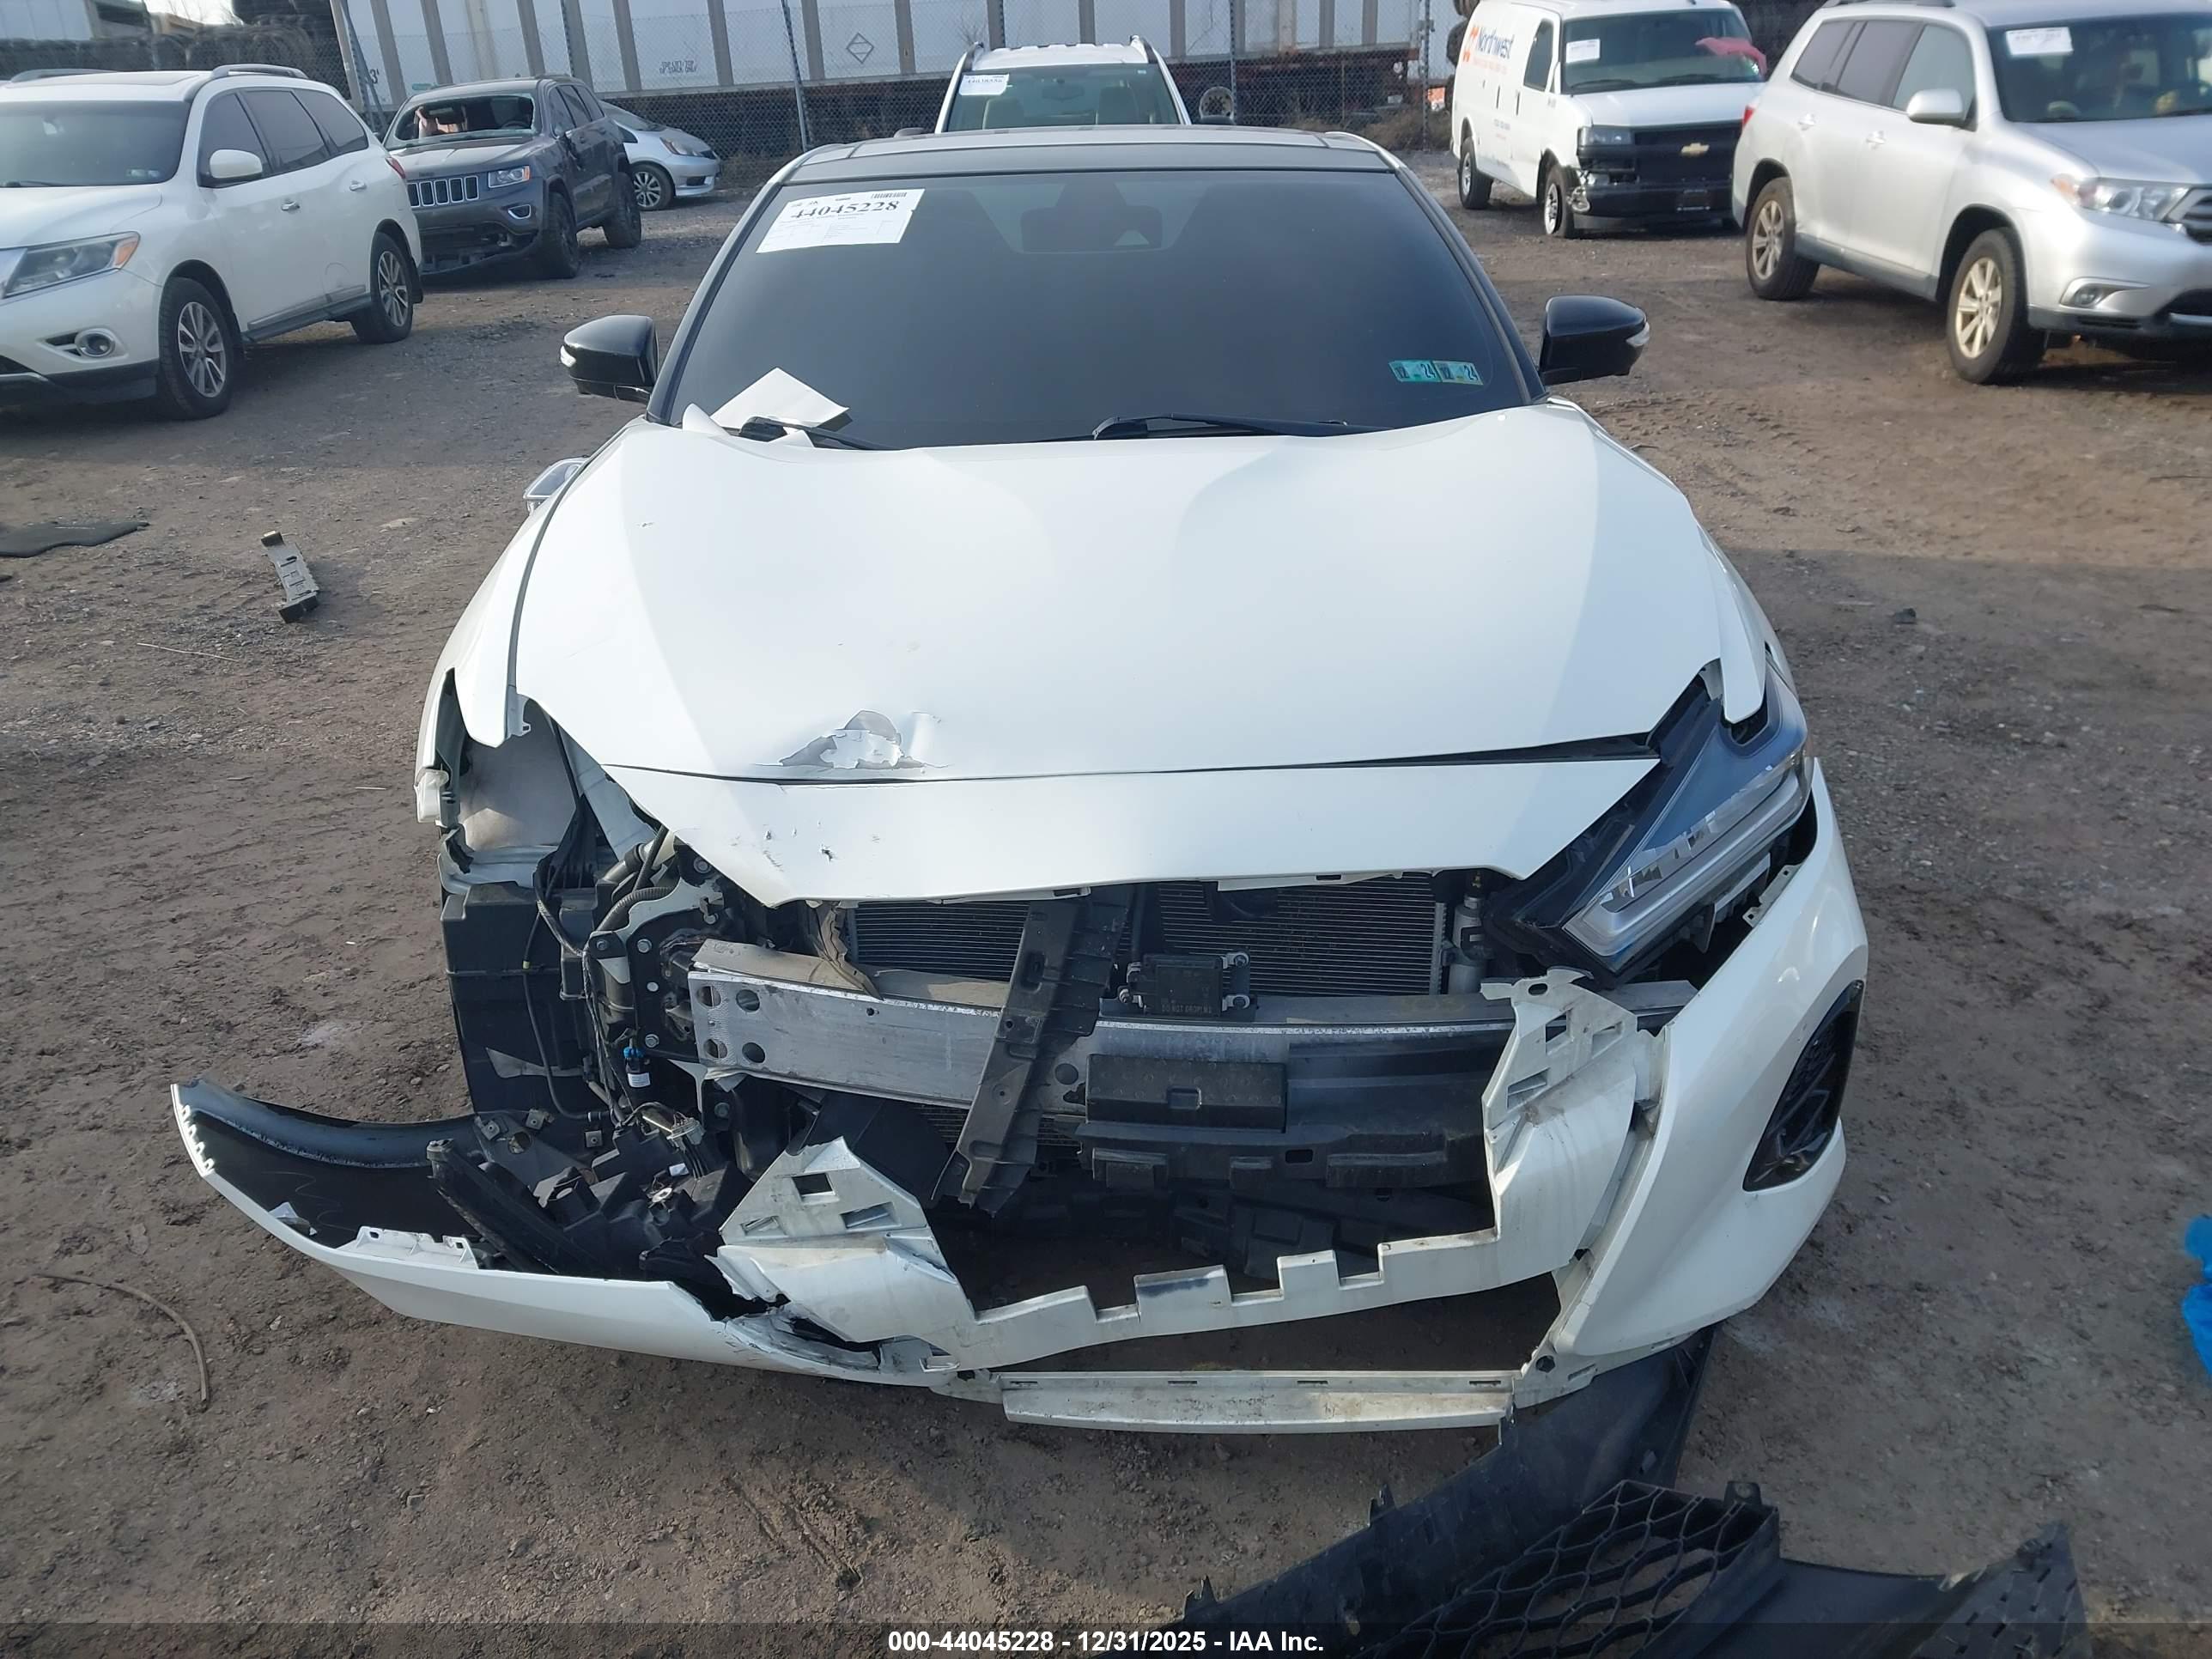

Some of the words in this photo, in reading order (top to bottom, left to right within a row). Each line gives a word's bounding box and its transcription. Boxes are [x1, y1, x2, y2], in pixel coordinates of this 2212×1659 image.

[1477, 27, 1515, 59] Northwest
[790, 200, 900, 218] 44045228
[1419, 363, 1437, 379] 24
[1463, 365, 1479, 380] 24
